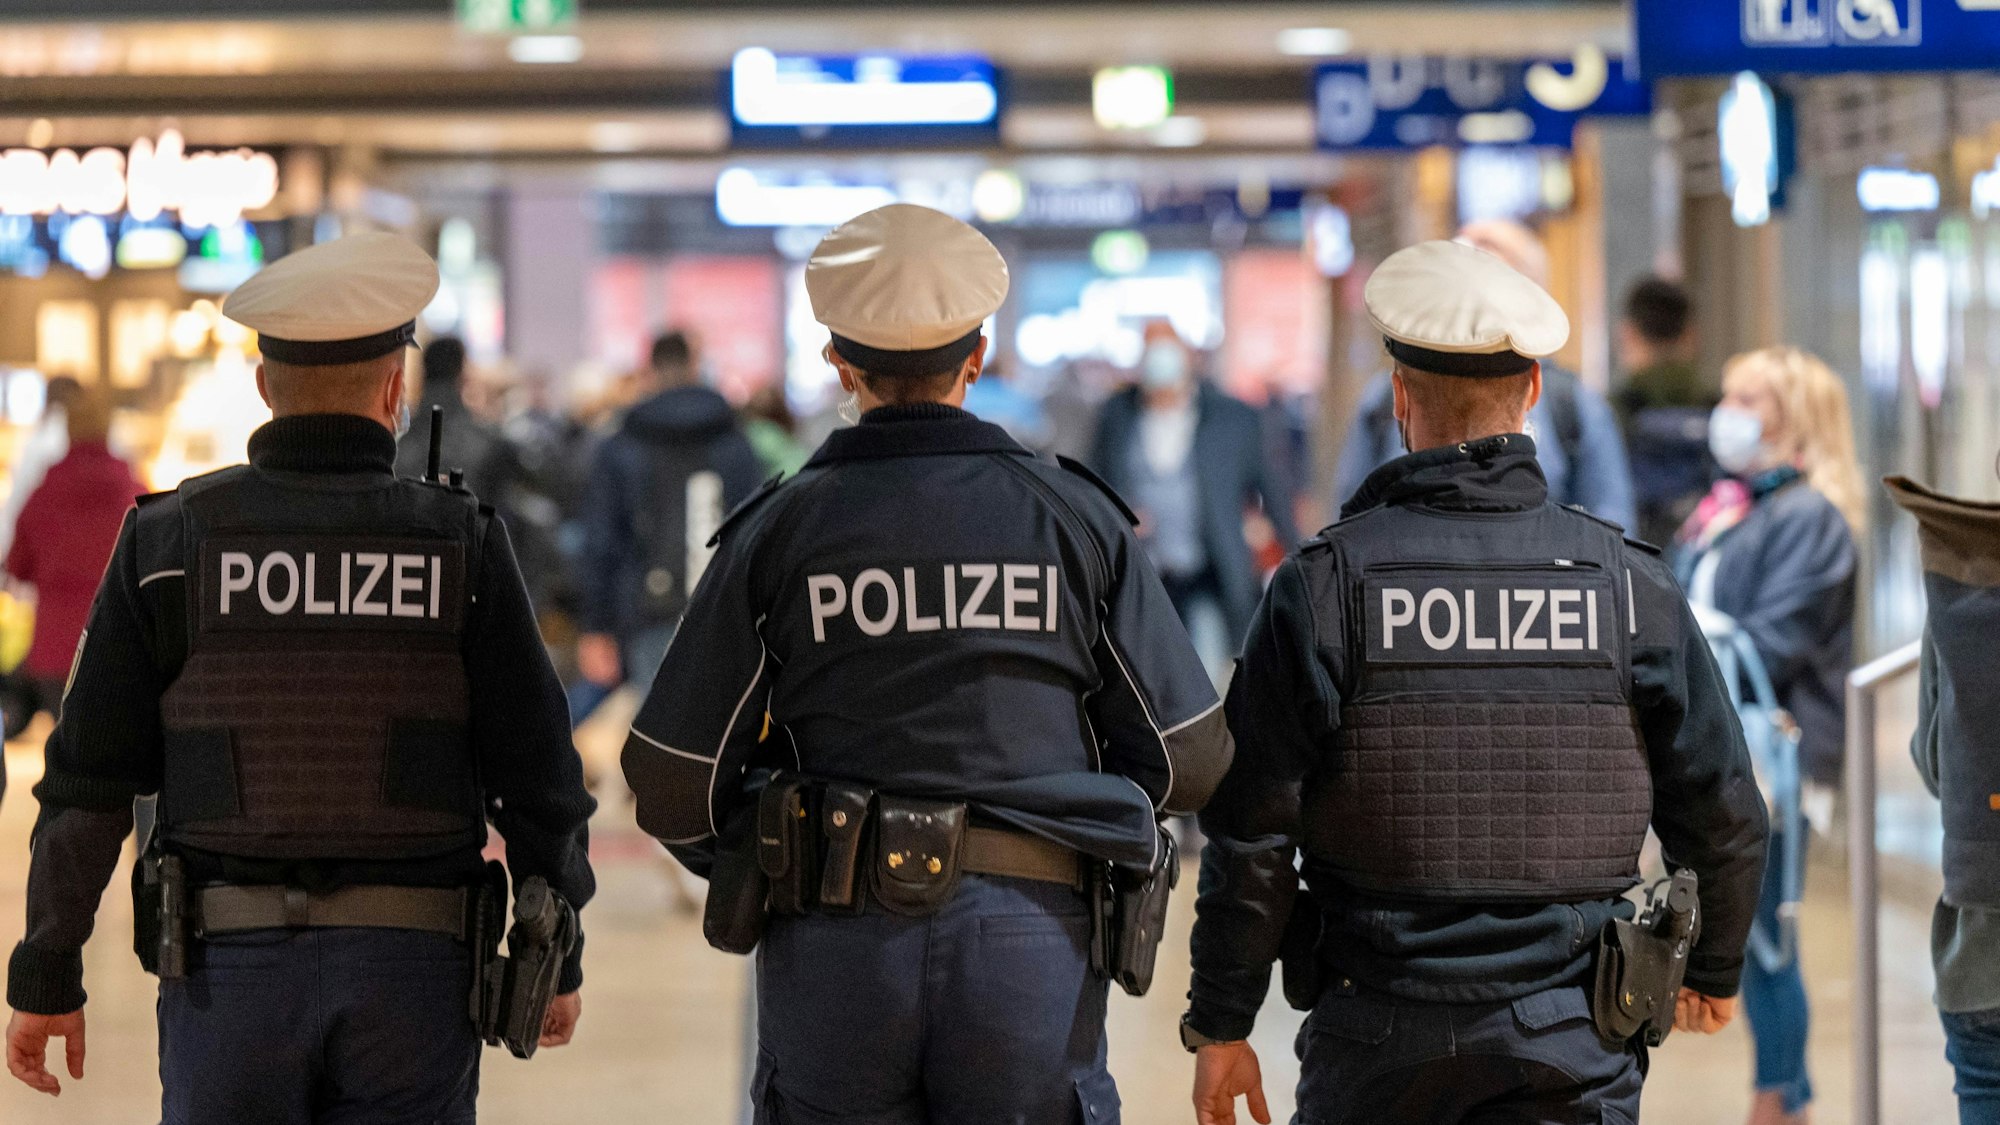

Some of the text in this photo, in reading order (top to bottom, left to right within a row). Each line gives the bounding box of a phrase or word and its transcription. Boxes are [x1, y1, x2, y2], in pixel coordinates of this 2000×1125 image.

[220, 551, 441, 618] POLIZEI
[807, 563, 1058, 642] POLIZEI
[1381, 587, 1599, 651] POLIZEI
